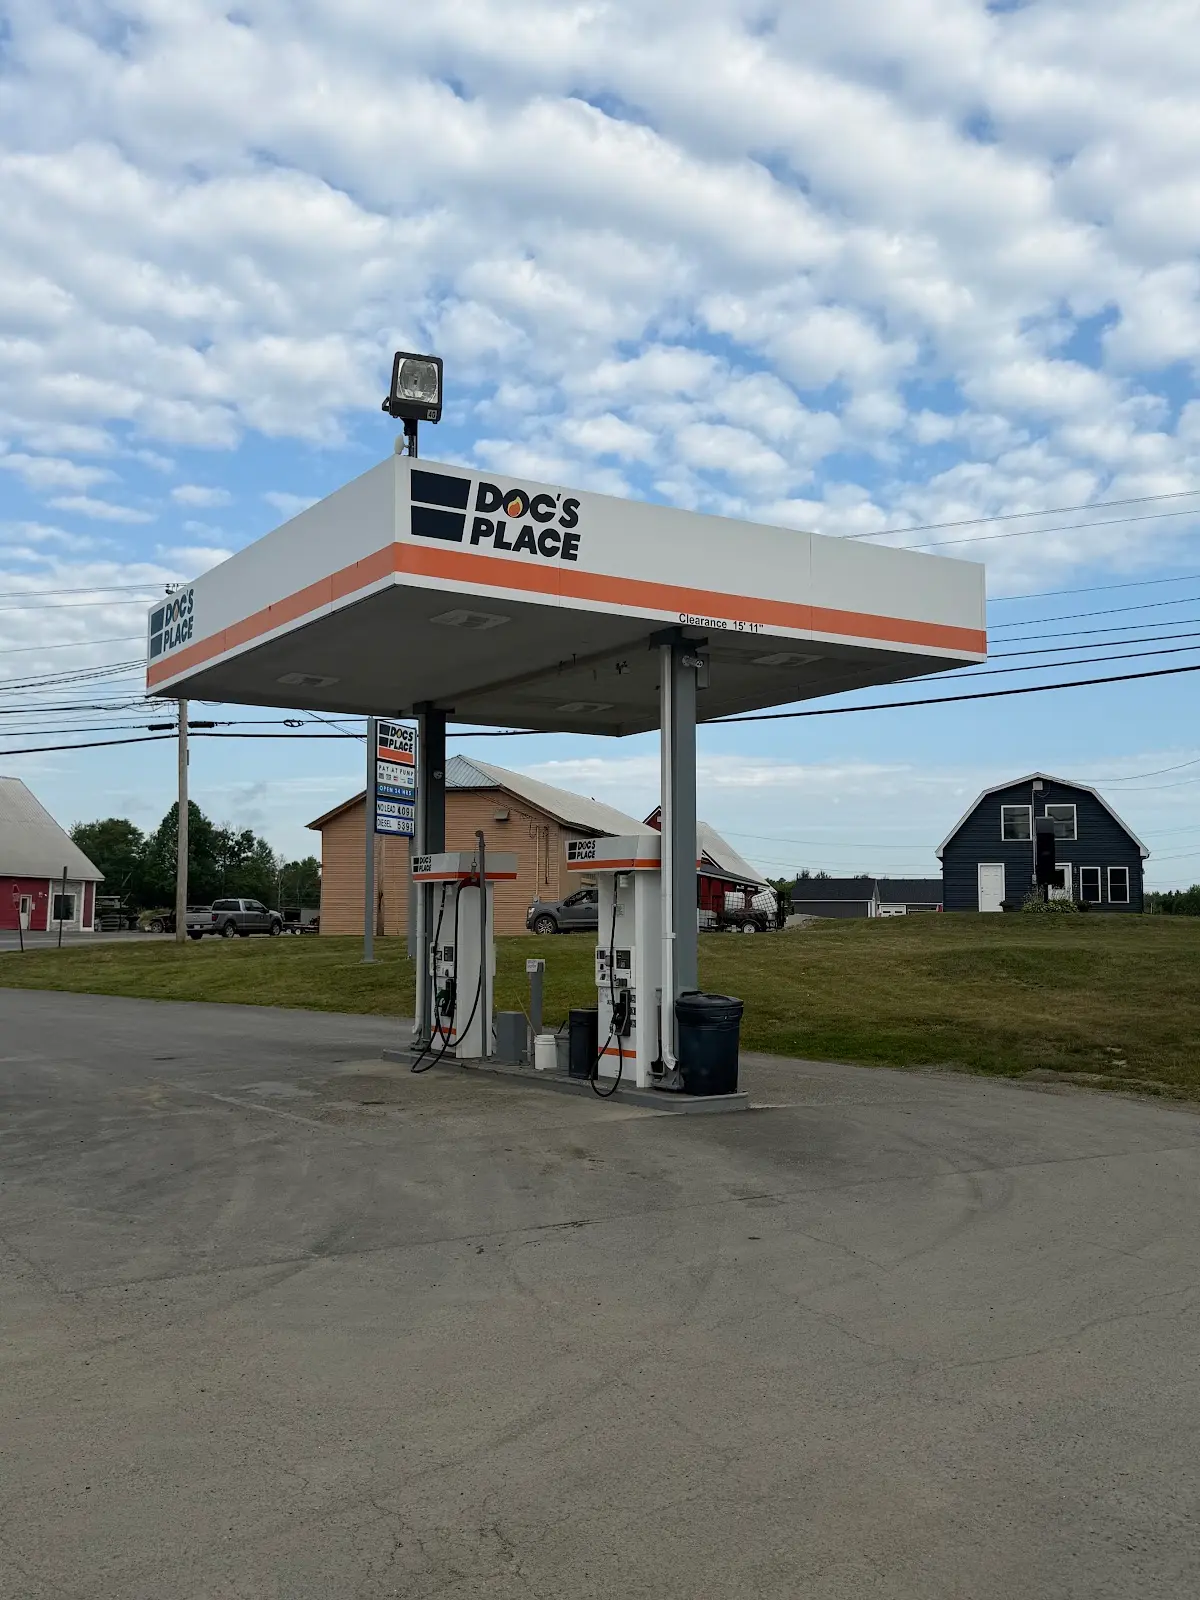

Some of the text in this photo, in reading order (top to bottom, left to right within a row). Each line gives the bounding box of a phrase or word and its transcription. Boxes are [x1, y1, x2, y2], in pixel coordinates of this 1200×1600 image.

[475, 482, 581, 528] DOC'S
[470, 517, 581, 561] PLACE
[165, 589, 194, 627] DOC'S
[679, 613, 764, 633] Clearance 15' 11"
[163, 615, 194, 652] PLACE
[388, 739, 414, 753] PLACE
[378, 764, 413, 776] PAY AT PUMP
[379, 785, 394, 794] OPEN
[377, 818, 392, 828] DIESEL
[576, 850, 596, 860] PLACE
